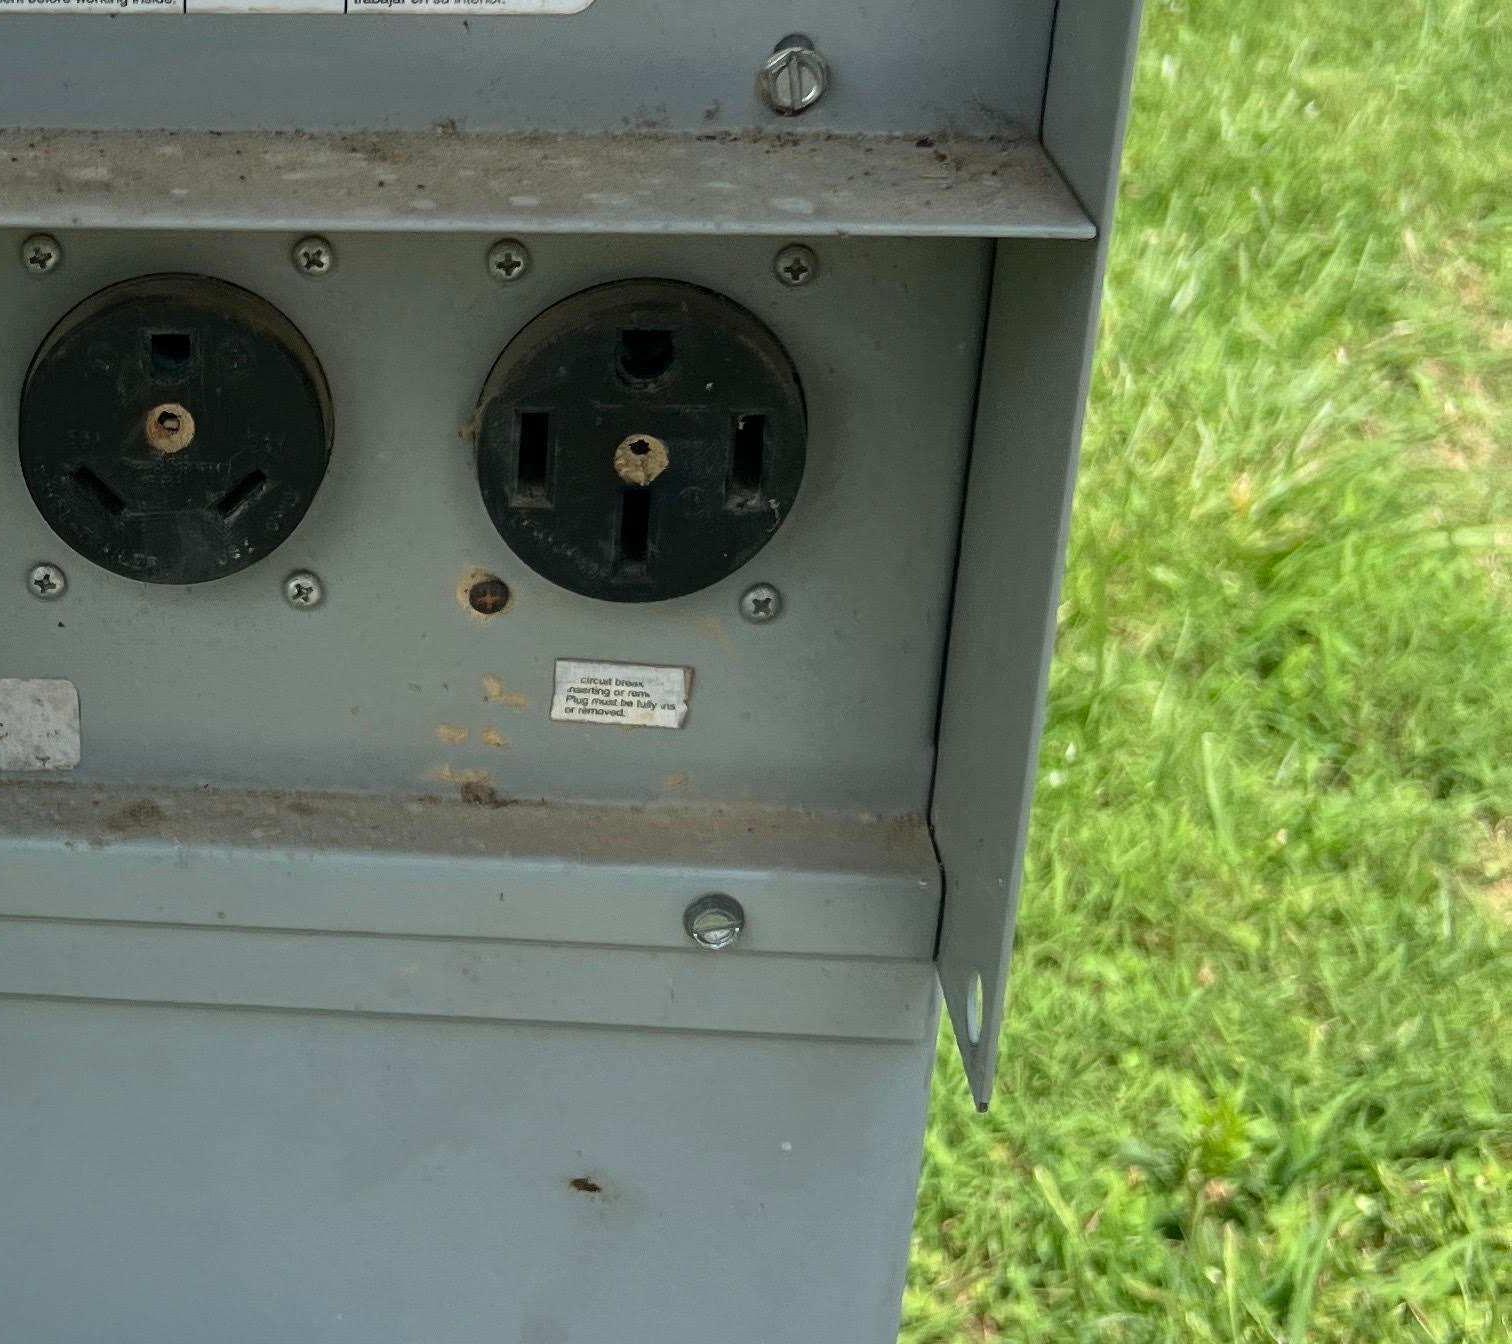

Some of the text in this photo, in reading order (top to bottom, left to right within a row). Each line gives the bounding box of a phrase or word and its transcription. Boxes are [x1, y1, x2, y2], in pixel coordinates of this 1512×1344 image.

[614, 690, 626, 698] or
[565, 694, 589, 707] Plug
[591, 697, 618, 707] must
[620, 698, 634, 707] be
[637, 699, 657, 712] fully
[577, 707, 626, 718] removed.
